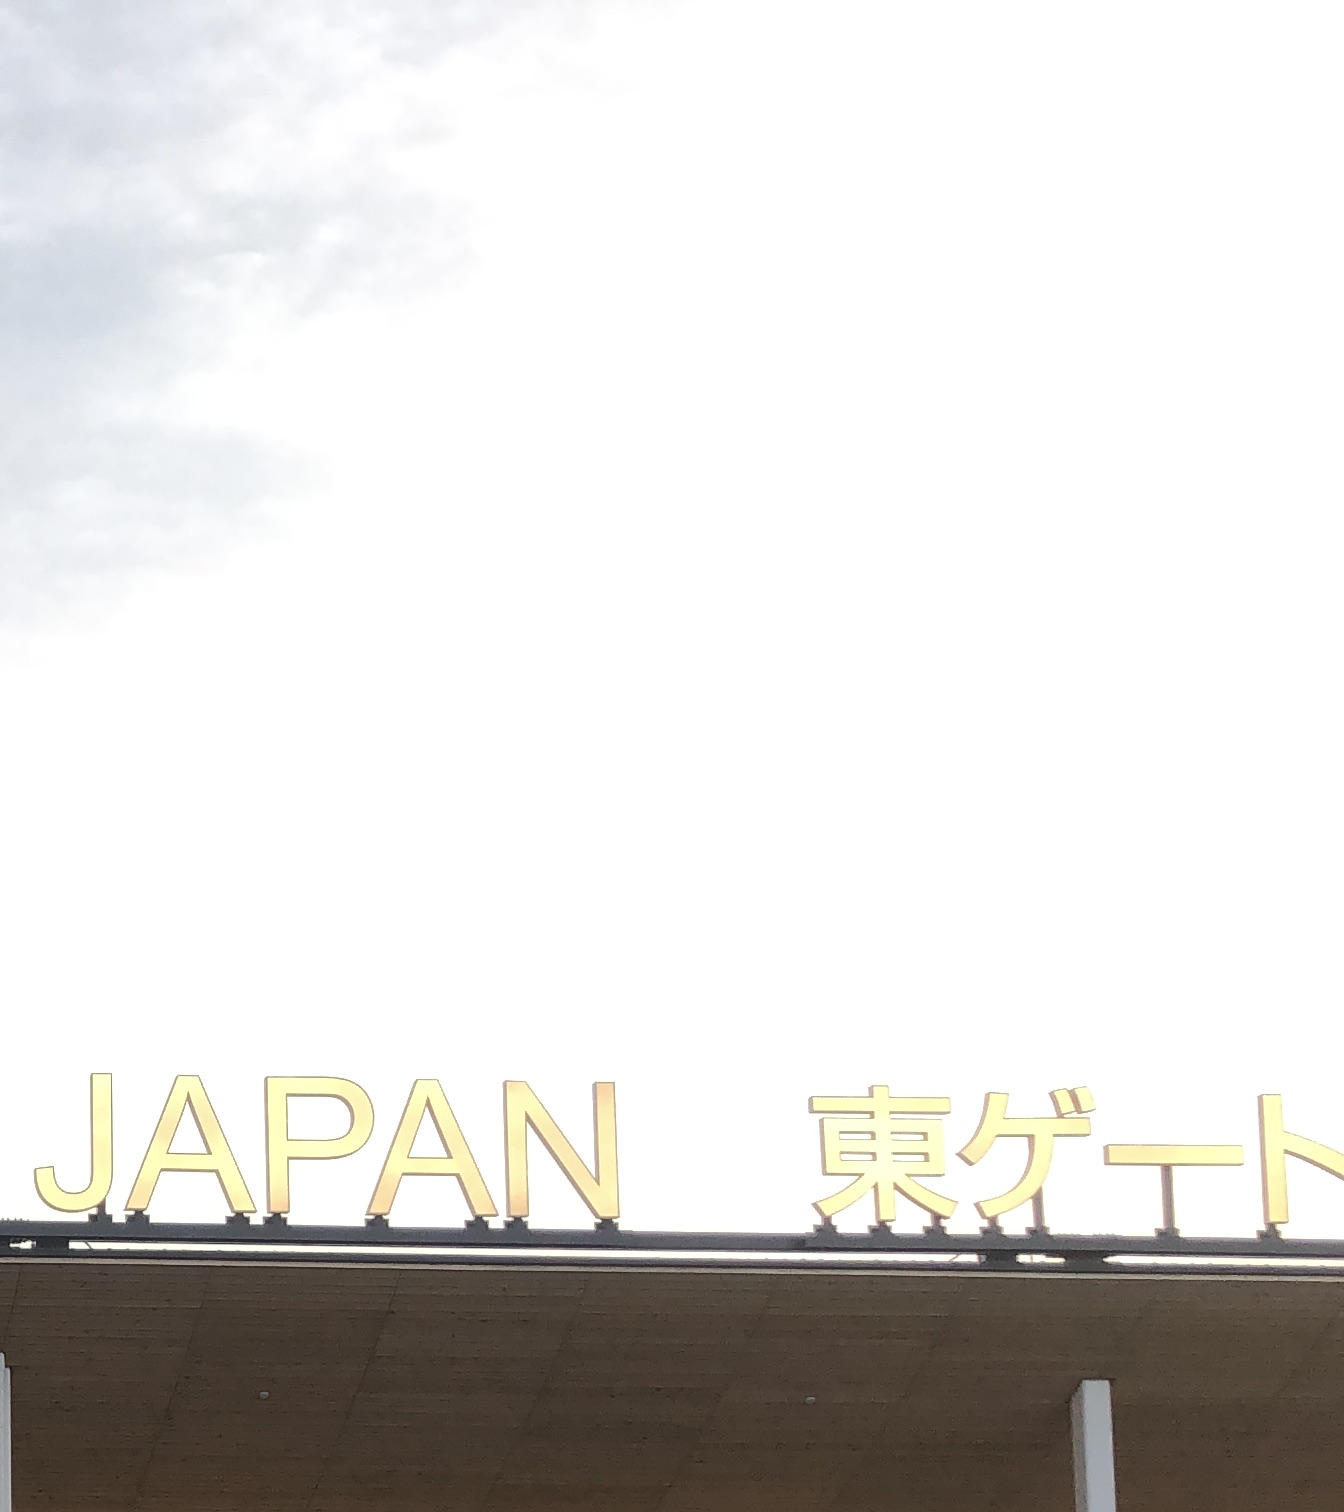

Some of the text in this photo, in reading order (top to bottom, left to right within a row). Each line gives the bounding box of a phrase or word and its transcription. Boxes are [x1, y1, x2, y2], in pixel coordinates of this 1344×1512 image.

[34, 1072, 621, 1219] JAPAN
[808, 1084, 1344, 1226] 東ゲート
